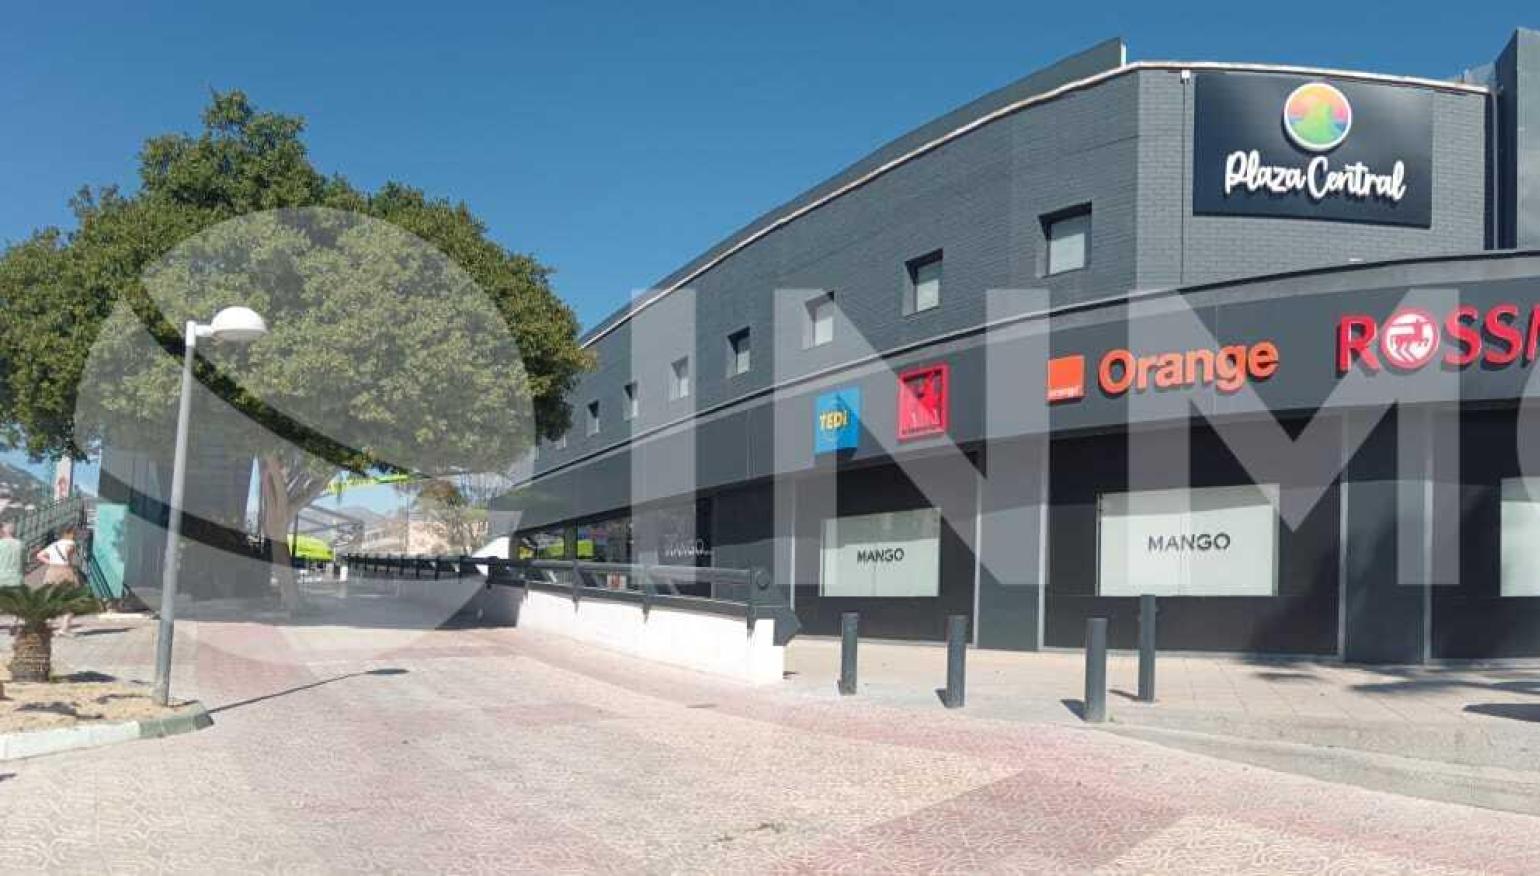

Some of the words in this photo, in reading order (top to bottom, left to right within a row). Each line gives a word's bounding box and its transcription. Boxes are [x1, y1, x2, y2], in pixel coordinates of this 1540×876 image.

[1225, 150, 1306, 195] Plaza
[1307, 155, 1406, 201] Central
[1099, 340, 1279, 394] Orange
[857, 547, 905, 564] MANGO
[1148, 532, 1231, 552] MANGO
